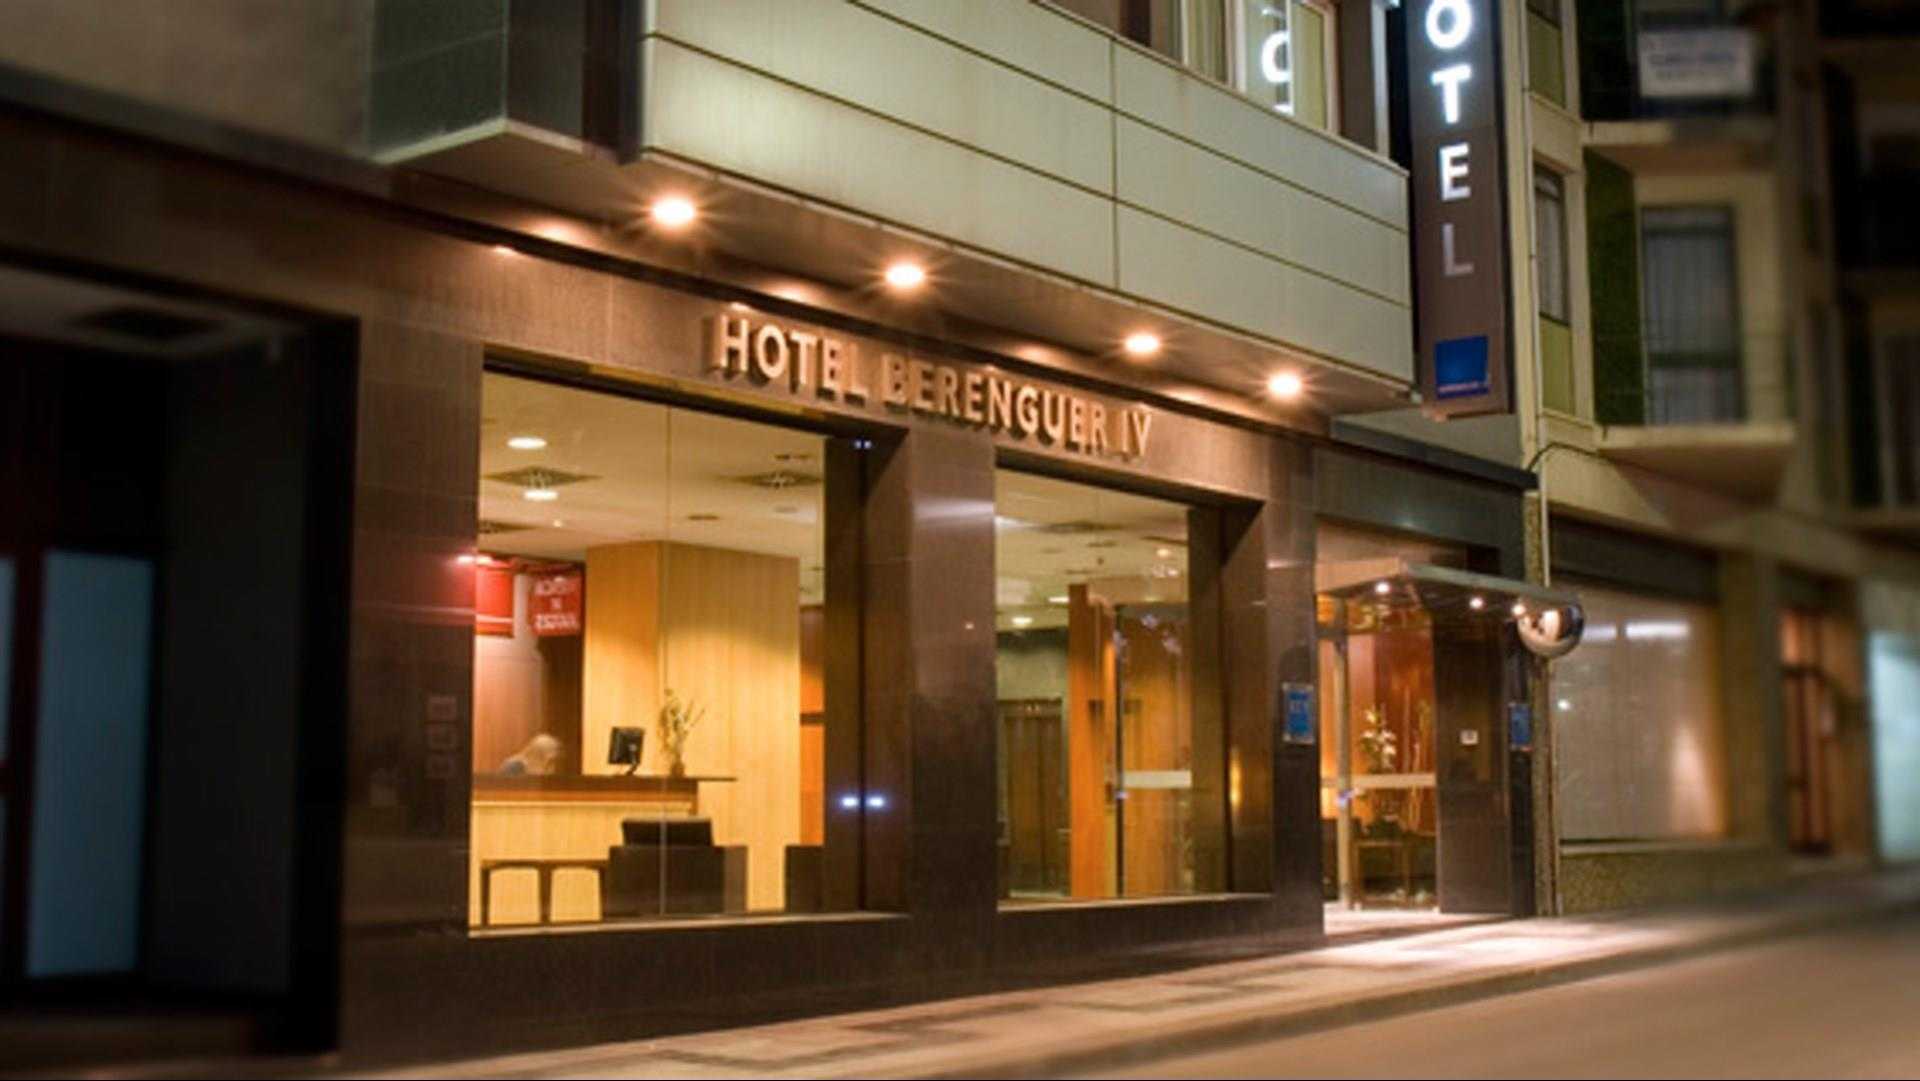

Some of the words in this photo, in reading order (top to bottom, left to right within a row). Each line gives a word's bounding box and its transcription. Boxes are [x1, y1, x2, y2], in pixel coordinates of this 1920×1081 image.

[717, 313, 869, 399] HOTEL
[881, 353, 1109, 452] BERENGUER
[1119, 409, 1151, 457] IV
